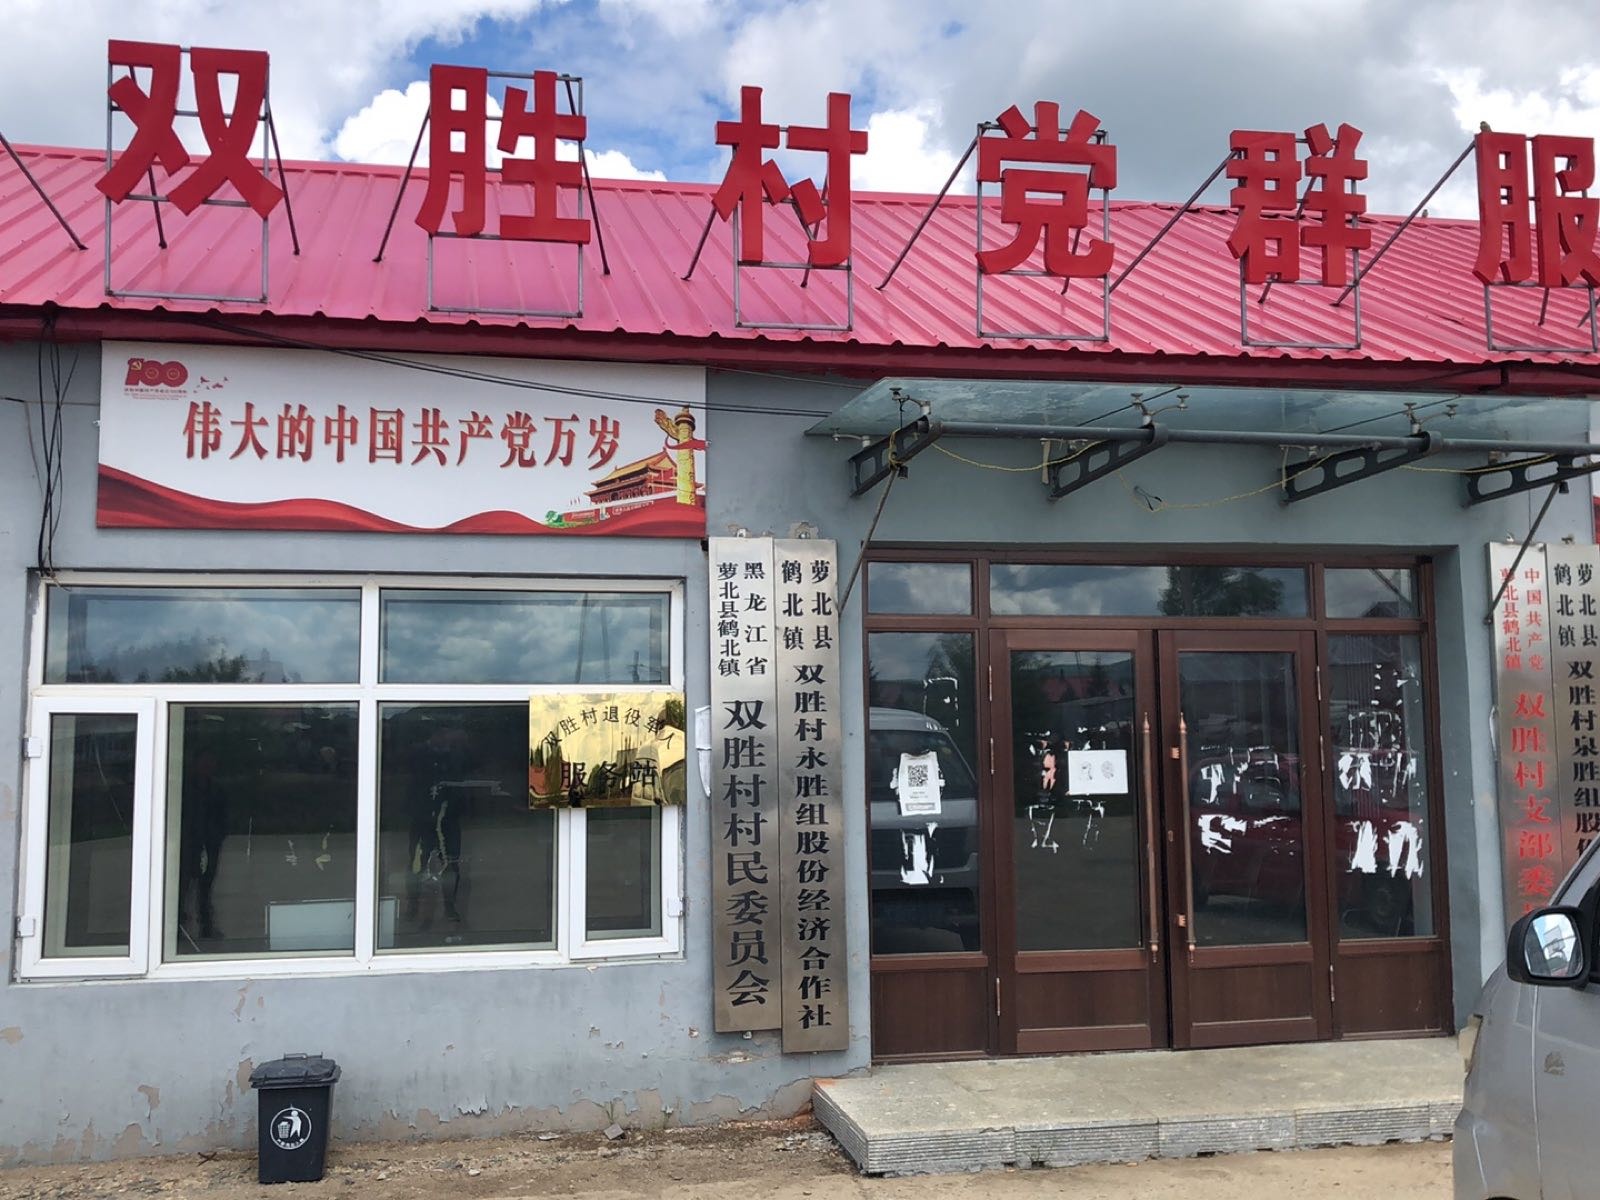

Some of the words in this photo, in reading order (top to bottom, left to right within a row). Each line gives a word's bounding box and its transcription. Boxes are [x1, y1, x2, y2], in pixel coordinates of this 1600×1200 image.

[95, 39, 1600, 289] 双胜村党群服
[183, 401, 620, 470] 伟大的中国共产党万岁
[717, 562, 741, 676] 萝北县鹤北镇
[743, 562, 768, 676] 黑龙江省
[781, 560, 804, 650] 鹤北镇
[809, 560, 833, 650] 萝北县
[1525, 567, 1545, 672] 中国共产党
[1554, 563, 1576, 647] 鹤北镇
[1577, 563, 1598, 647] 萝北县
[560, 760, 658, 791] 服务站
[1511, 692, 1552, 916] 双胜村支部委
[722, 699, 770, 1007] 双胜村村民委员会
[793, 664, 832, 1030] 双胜村永胜组股份经济合作社
